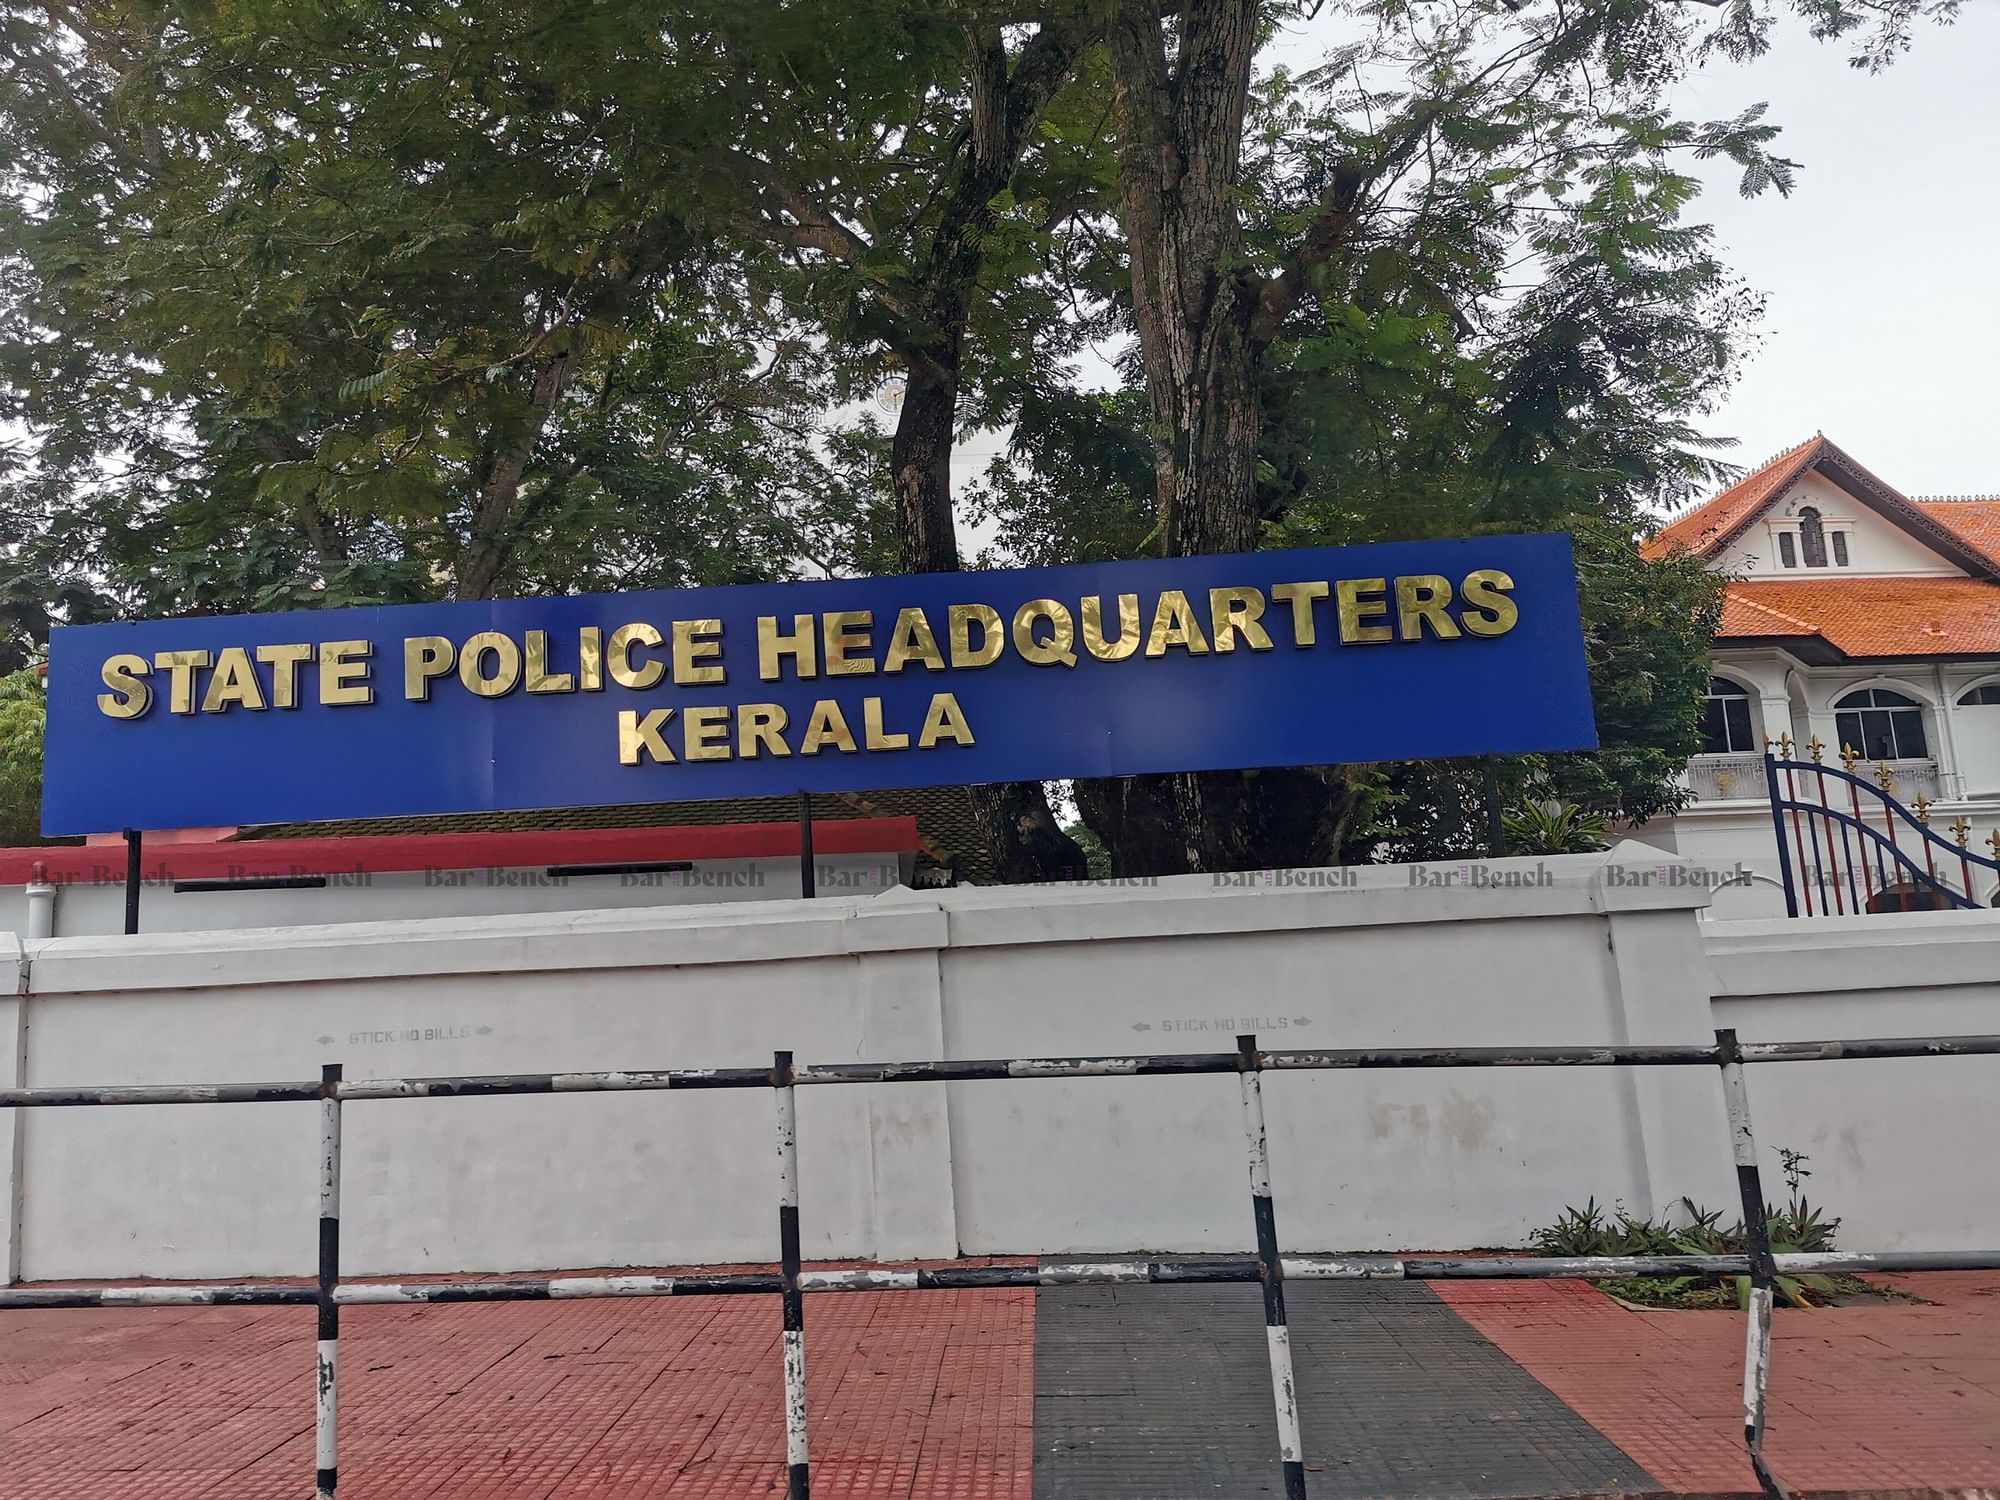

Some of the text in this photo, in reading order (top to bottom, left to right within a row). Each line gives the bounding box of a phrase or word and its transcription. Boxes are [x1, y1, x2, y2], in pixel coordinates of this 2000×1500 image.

[97, 568, 1520, 720] STATE POLICE HEADQUARTERS
[617, 692, 976, 766] KERALA
[349, 1030, 394, 1044] STICK
[424, 1026, 470, 1041] BILLS
[1162, 1019, 1208, 1032] STICK
